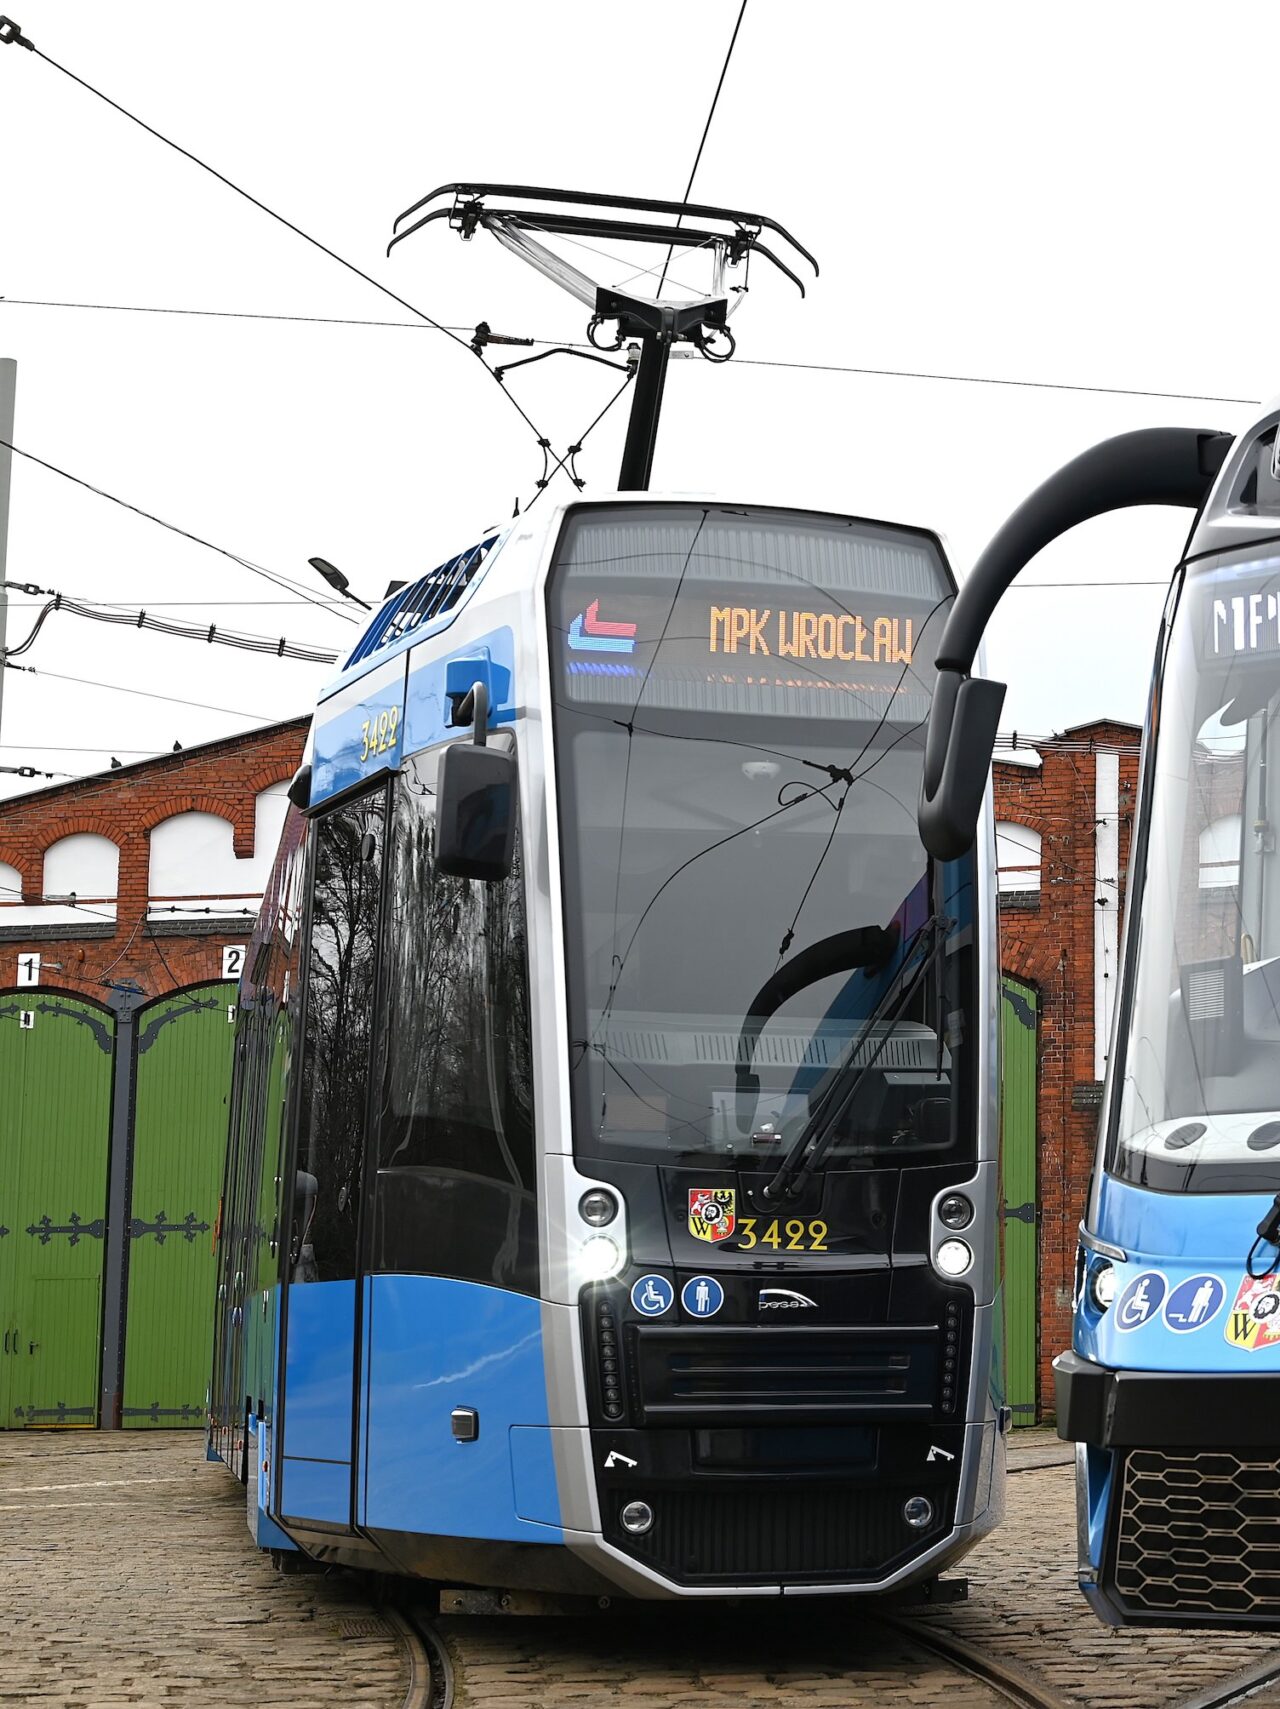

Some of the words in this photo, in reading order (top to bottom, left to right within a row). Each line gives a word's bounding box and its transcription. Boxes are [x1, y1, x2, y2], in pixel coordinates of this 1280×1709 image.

[709, 605, 771, 656] MPK
[778, 610, 913, 665] WROCŁAW
[360, 705, 399, 762] 3422
[23, 957, 34, 982] 1
[227, 950, 241, 974] 2
[690, 1216, 711, 1237] W
[737, 1217, 829, 1251] 3422
[1232, 1312, 1258, 1341] W
